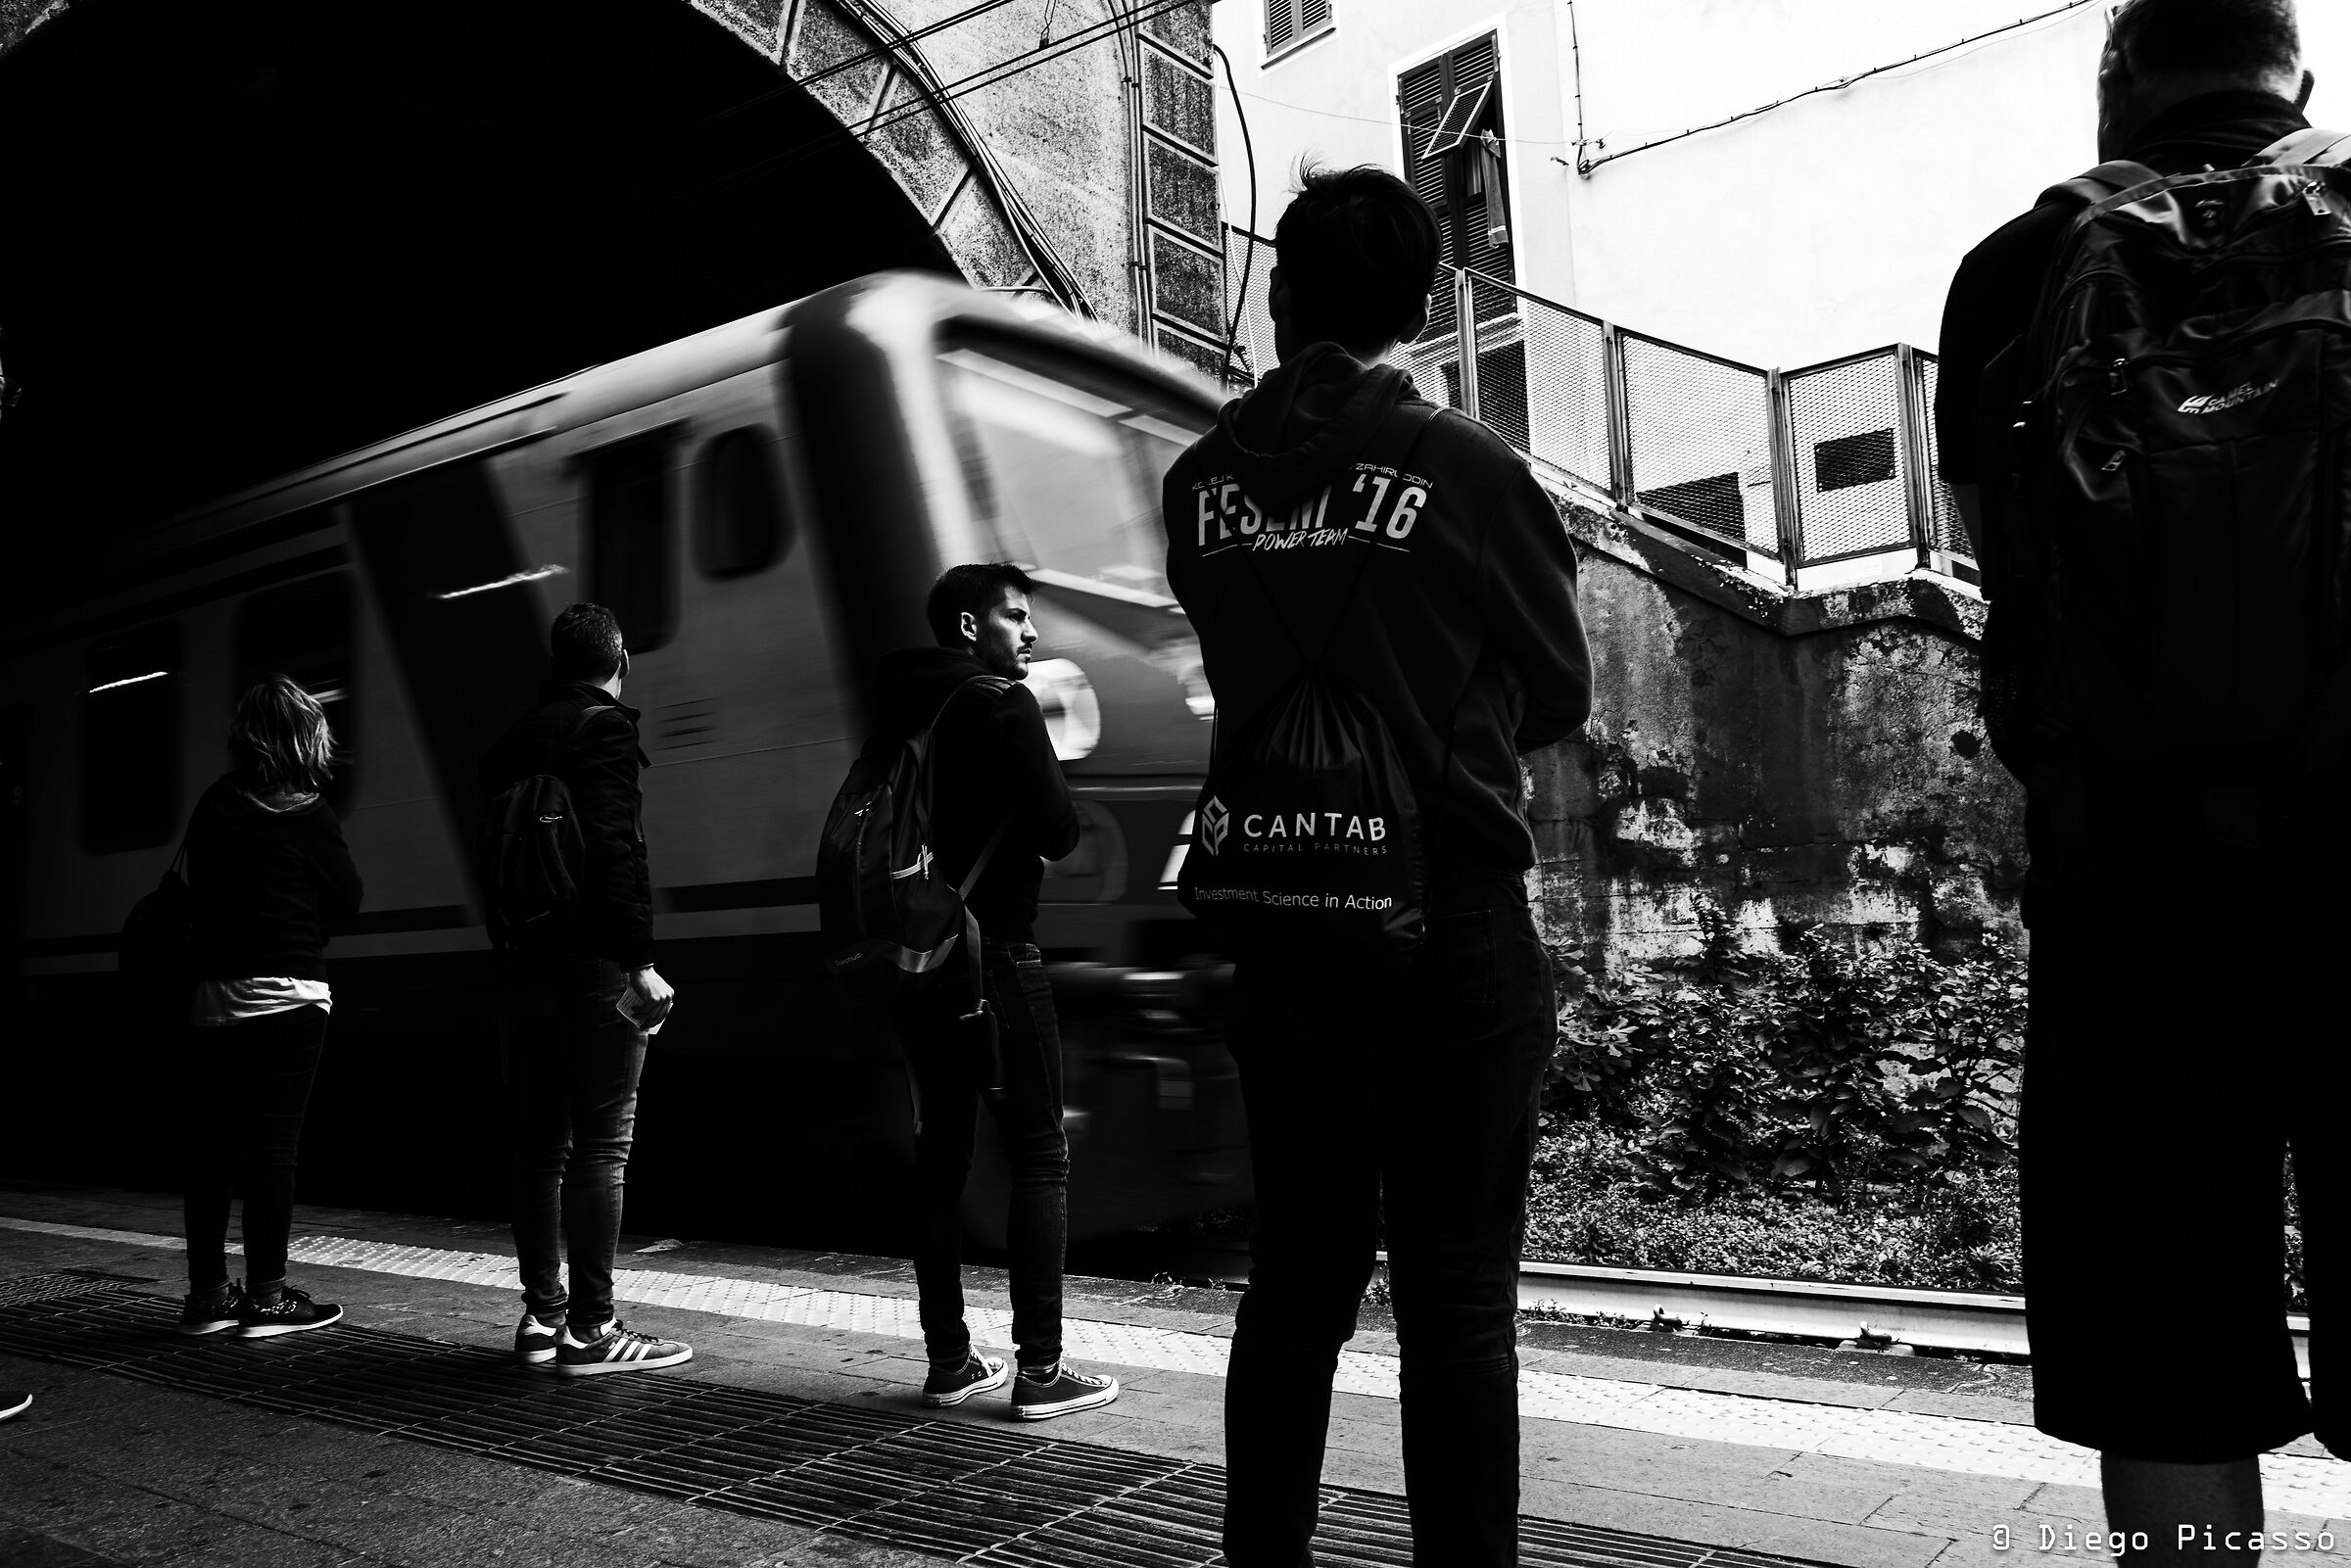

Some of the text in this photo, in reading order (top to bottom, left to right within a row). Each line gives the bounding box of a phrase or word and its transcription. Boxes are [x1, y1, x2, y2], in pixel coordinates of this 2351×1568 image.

[1253, 528, 1348, 551] POWER TEAM
[1243, 812, 1387, 841] CANTAB
[1243, 842, 1388, 857] CAPITAL PARTNERS
[1193, 886, 1393, 911] Investment Science in Action
